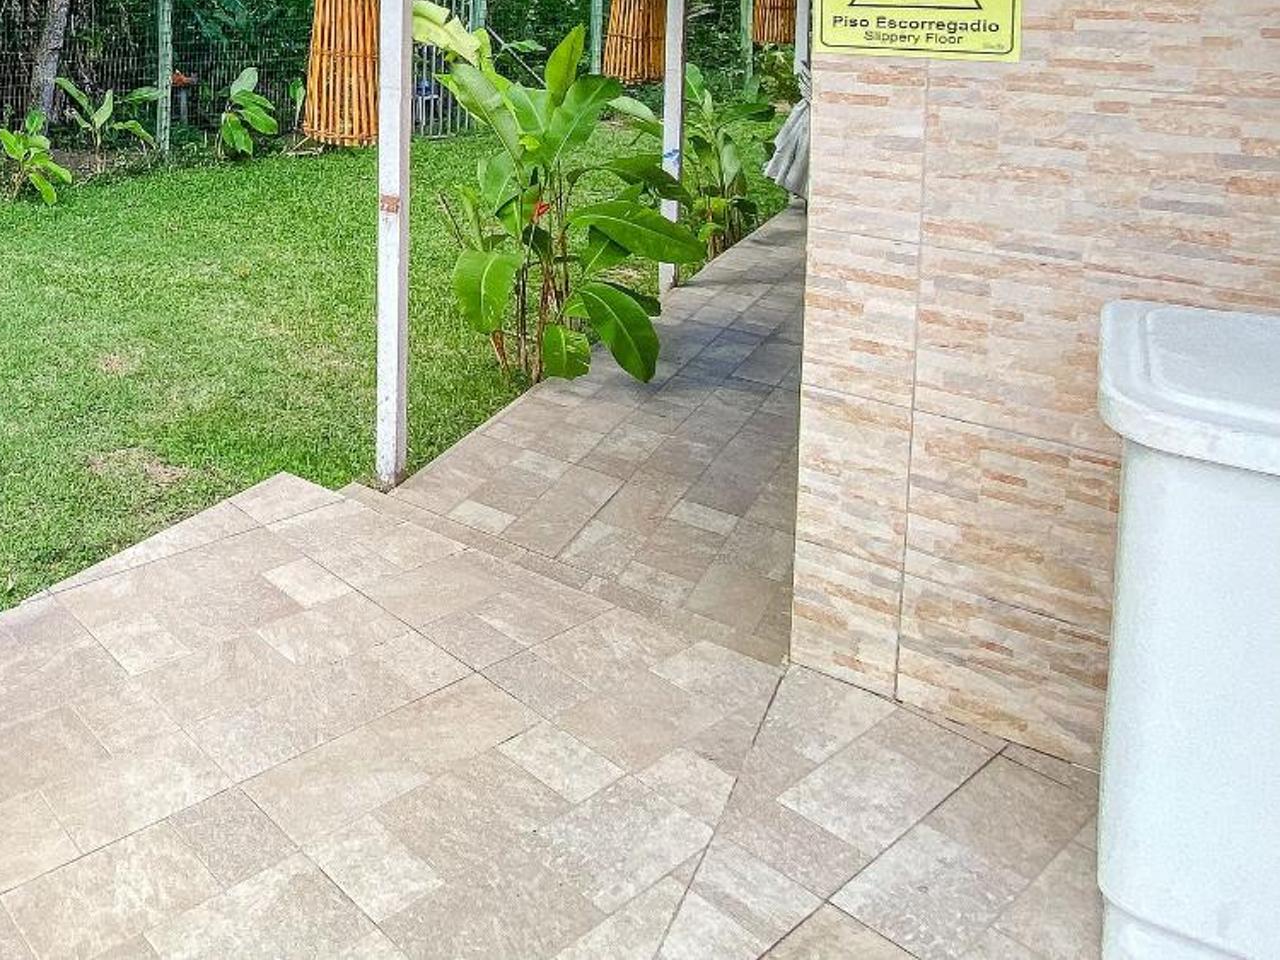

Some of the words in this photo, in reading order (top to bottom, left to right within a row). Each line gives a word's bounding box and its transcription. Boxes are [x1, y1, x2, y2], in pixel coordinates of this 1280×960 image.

[832, 15, 870, 28] Piso
[876, 16, 1000, 34] Escorregadio
[863, 31, 921, 44] Slippery
[925, 33, 963, 45] Floor
